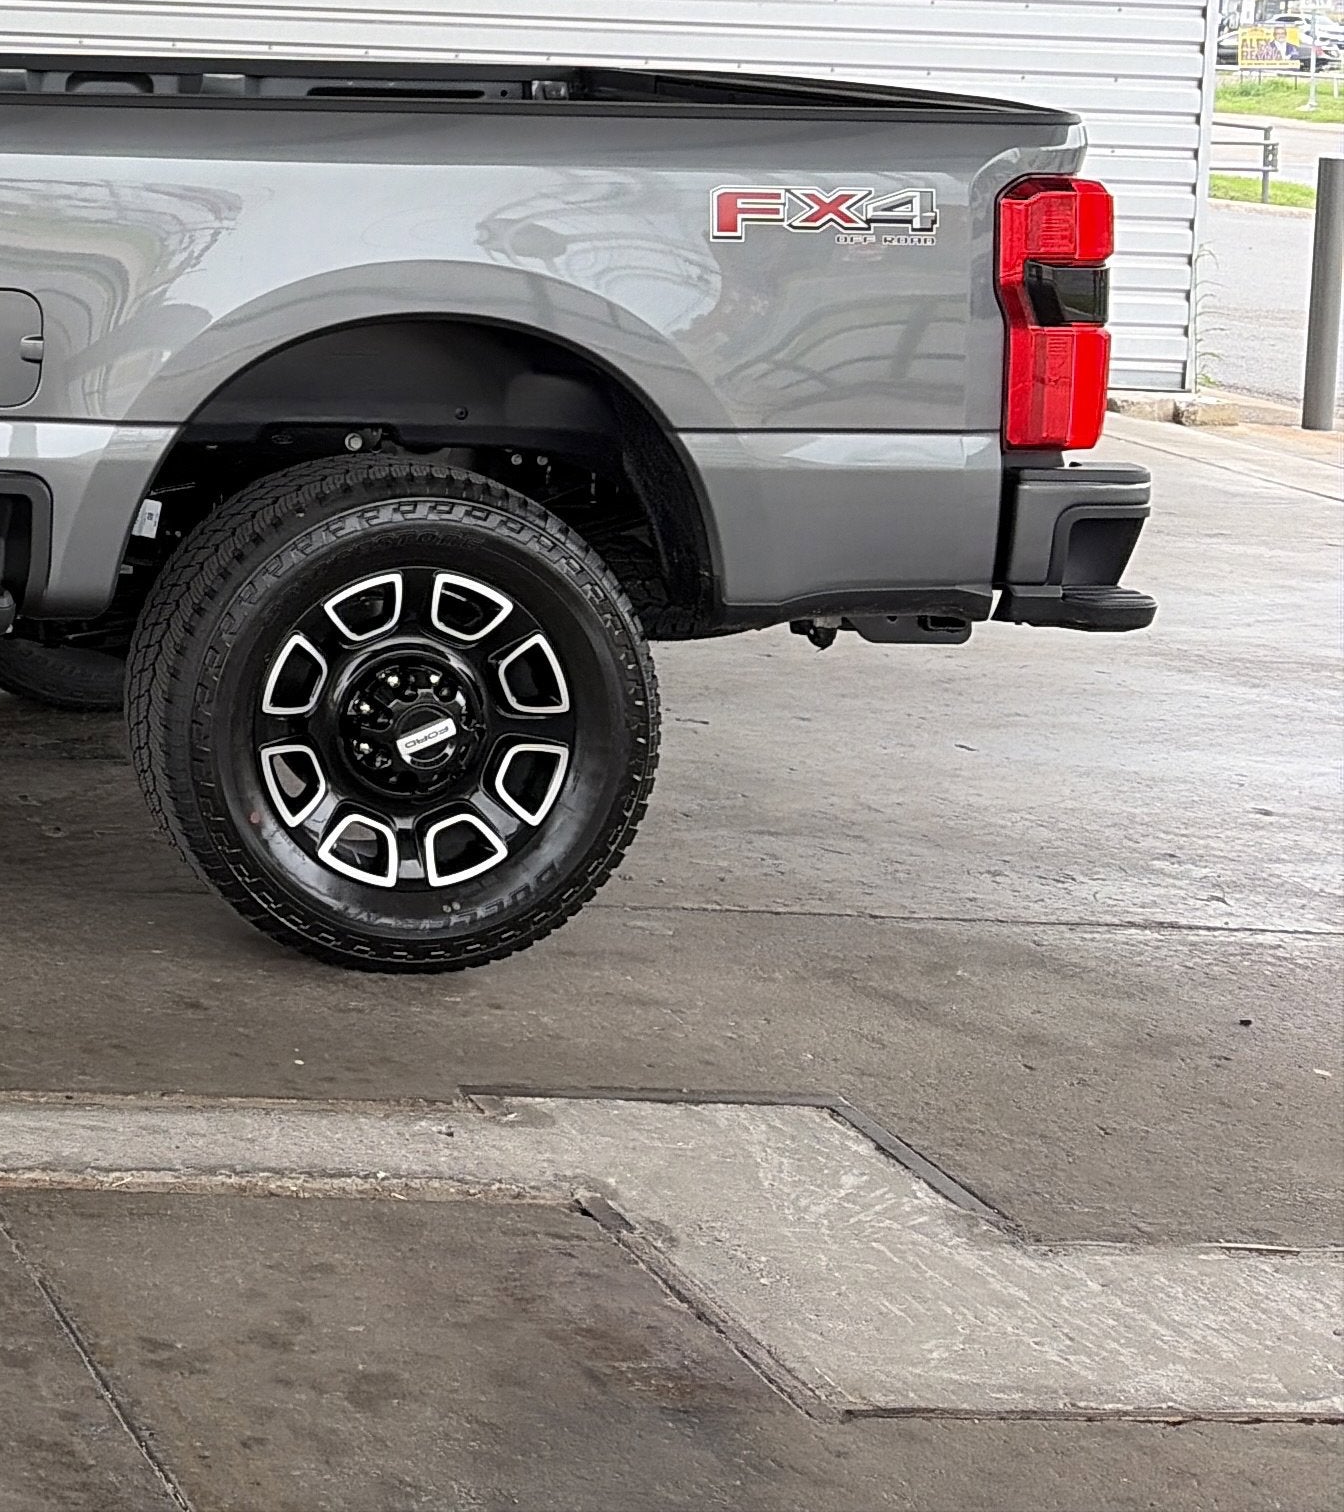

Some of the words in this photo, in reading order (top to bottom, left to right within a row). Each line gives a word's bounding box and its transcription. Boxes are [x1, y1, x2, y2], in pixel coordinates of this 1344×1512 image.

[710, 185, 939, 242] FX4
[835, 234, 875, 245] OFF
[882, 235, 936, 246] ROAD
[404, 726, 449, 749] FORD
